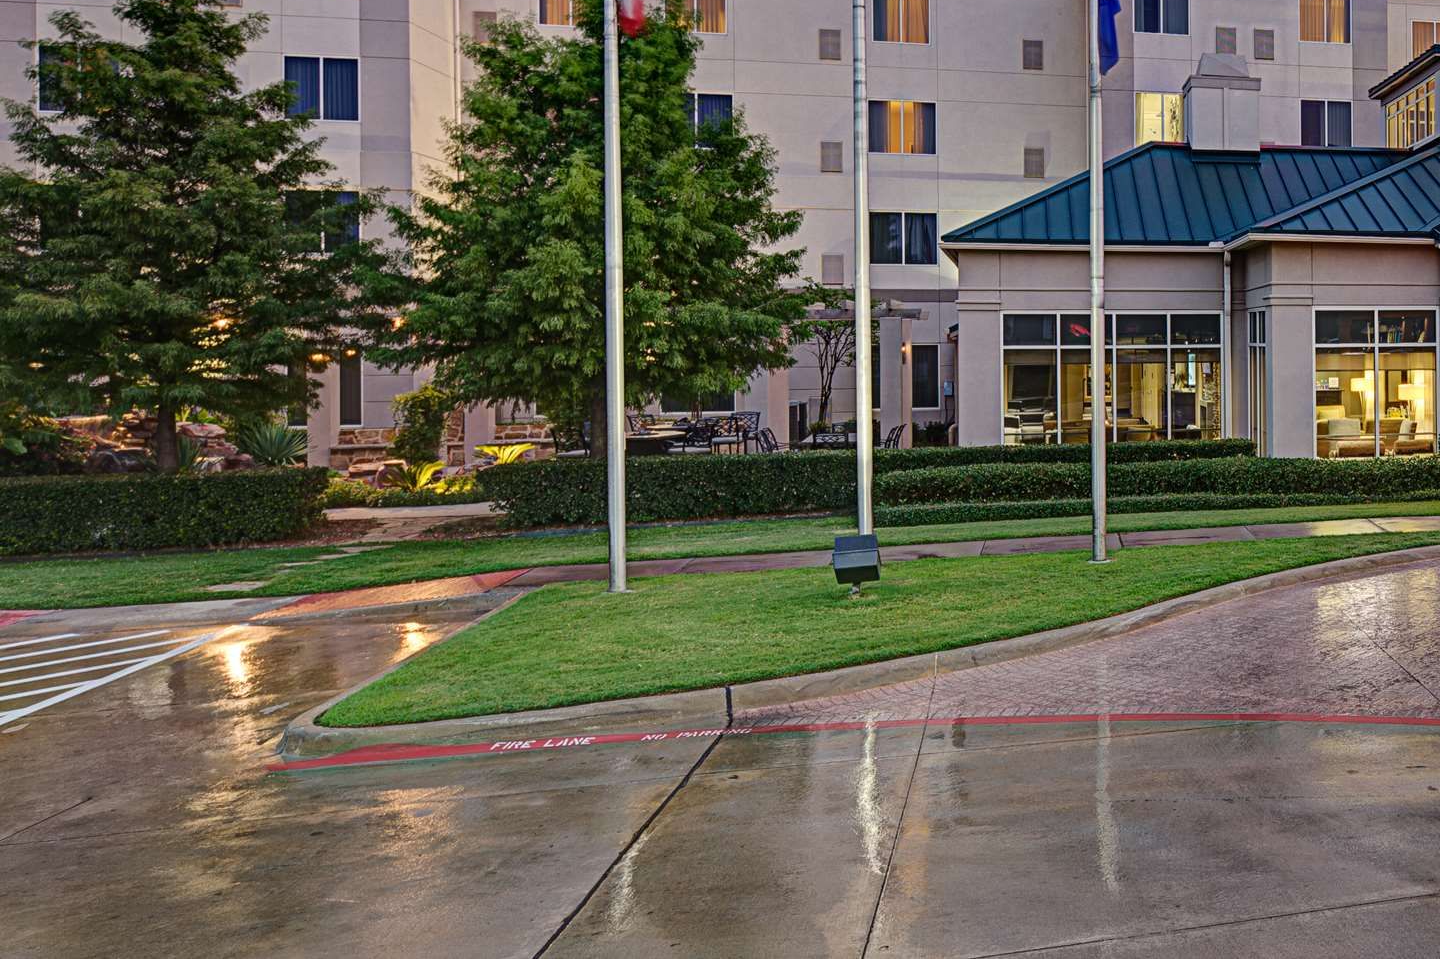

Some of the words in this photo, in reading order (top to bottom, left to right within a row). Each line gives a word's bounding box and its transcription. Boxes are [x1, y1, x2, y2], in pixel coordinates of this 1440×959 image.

[490, 740, 536, 751] FIRE
[543, 736, 596, 747] LANE
[641, 733, 668, 741] NO
